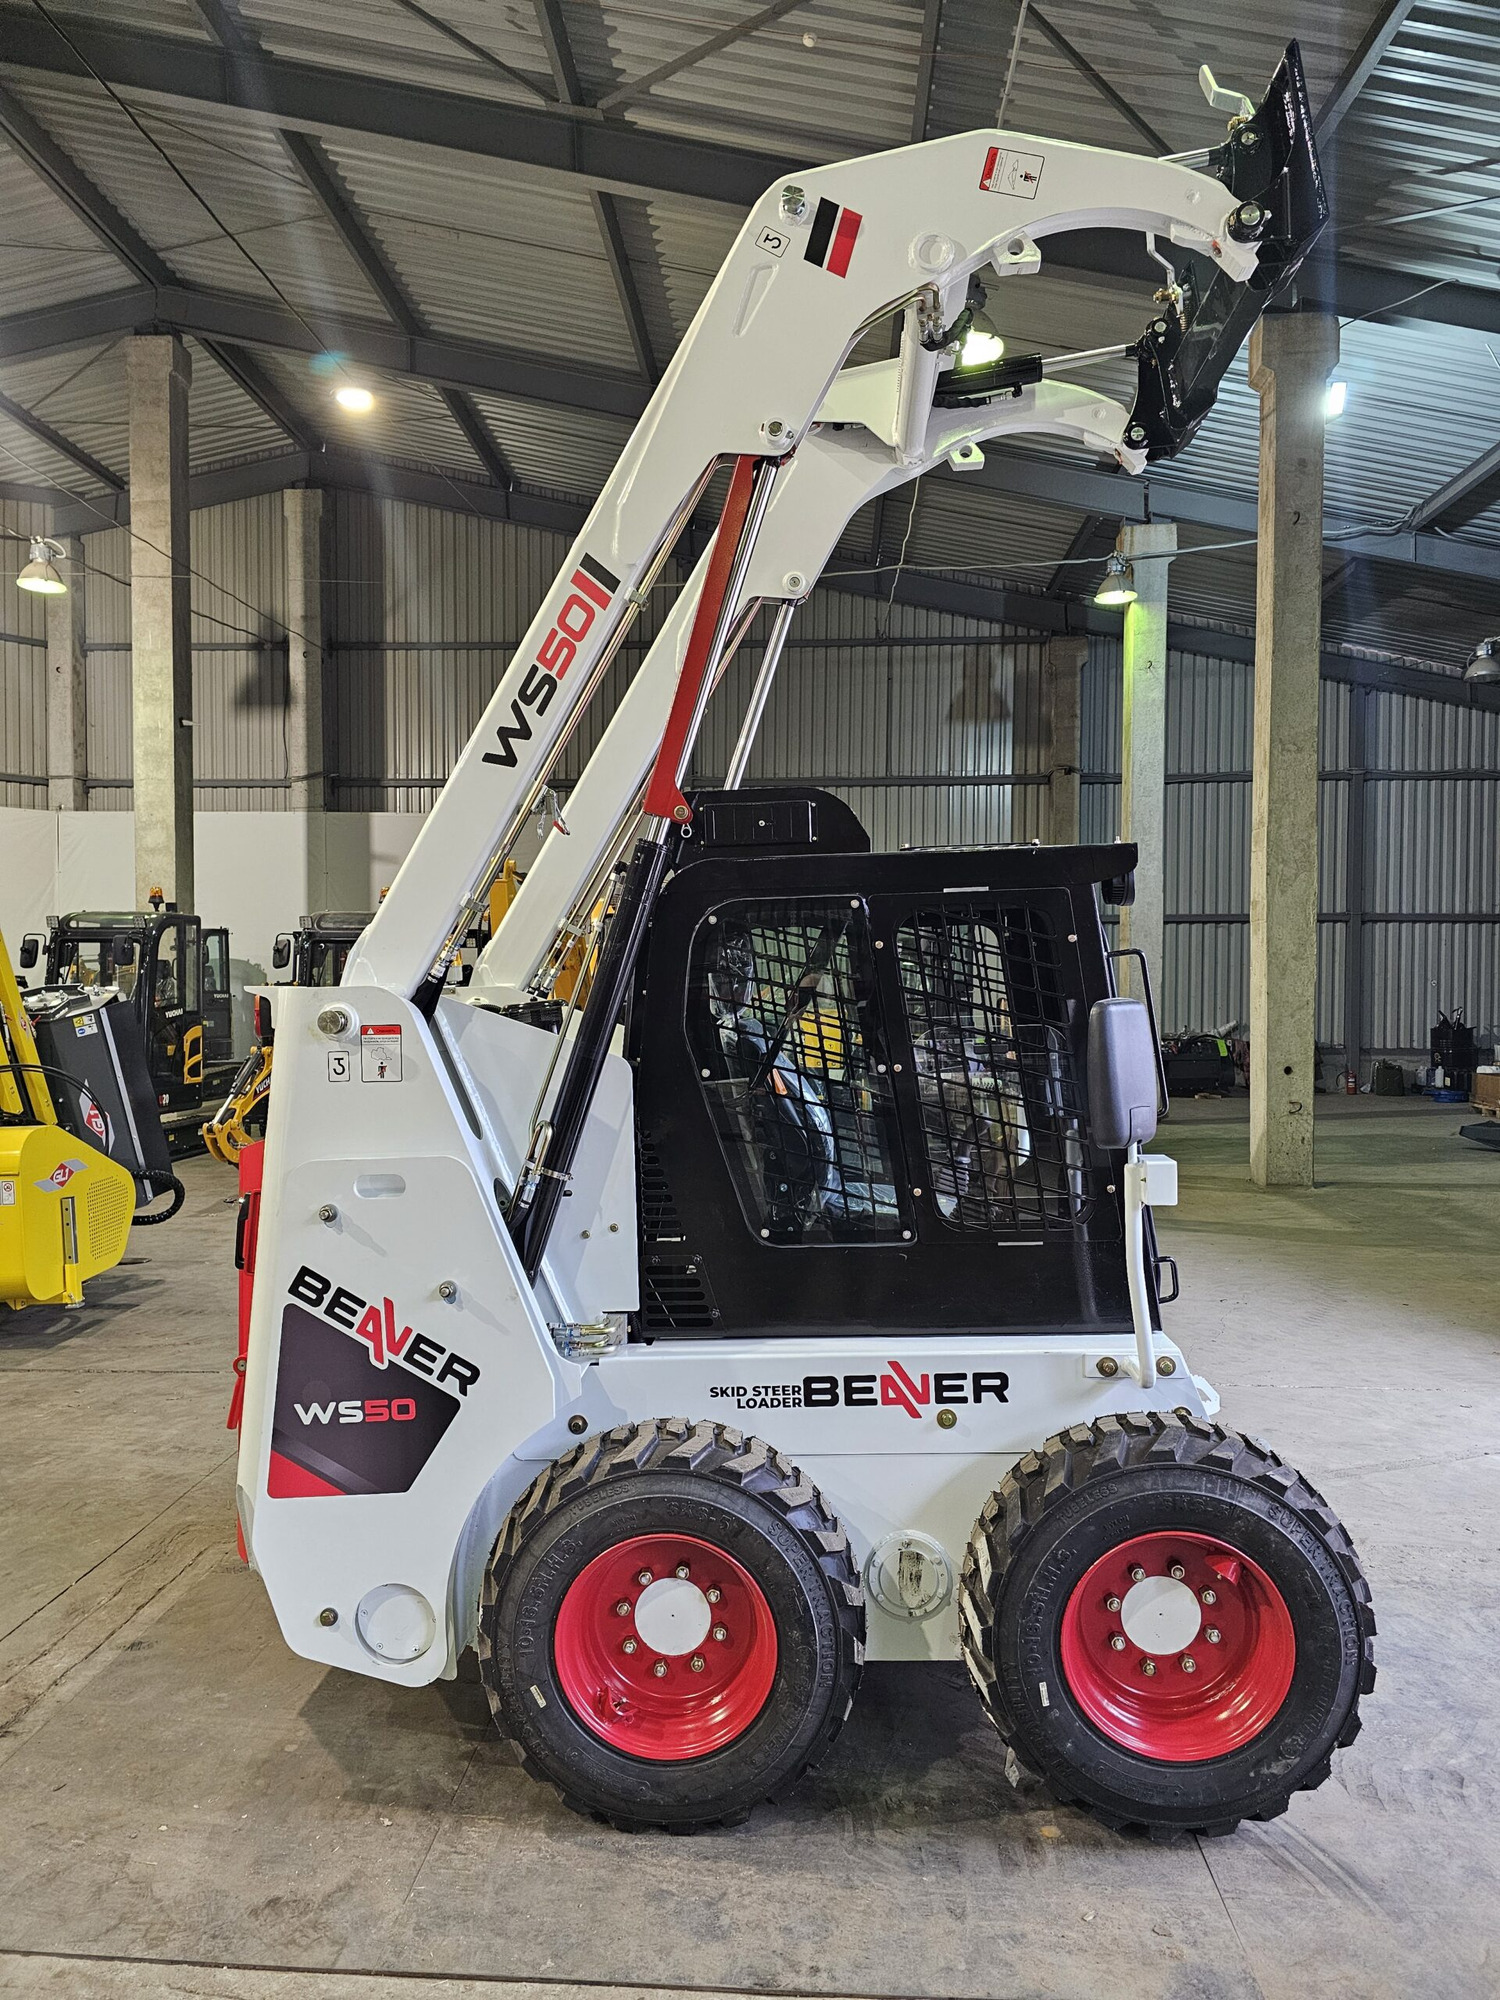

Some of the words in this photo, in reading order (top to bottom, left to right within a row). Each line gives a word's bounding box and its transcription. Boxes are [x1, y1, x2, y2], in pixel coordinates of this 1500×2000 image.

[481, 593, 596, 768] WS50
[165, 1008, 184, 1018] YUCHAI
[255, 1075, 272, 1094] YUCH
[53, 1167, 70, 1181] GL1
[287, 1264, 481, 1397] BEAVER
[709, 1385, 748, 1398] SKID
[752, 1384, 802, 1397] STEER
[803, 1360, 1010, 1419] BEAVER
[293, 1397, 417, 1426] WS50
[736, 1397, 803, 1410] LOADER
